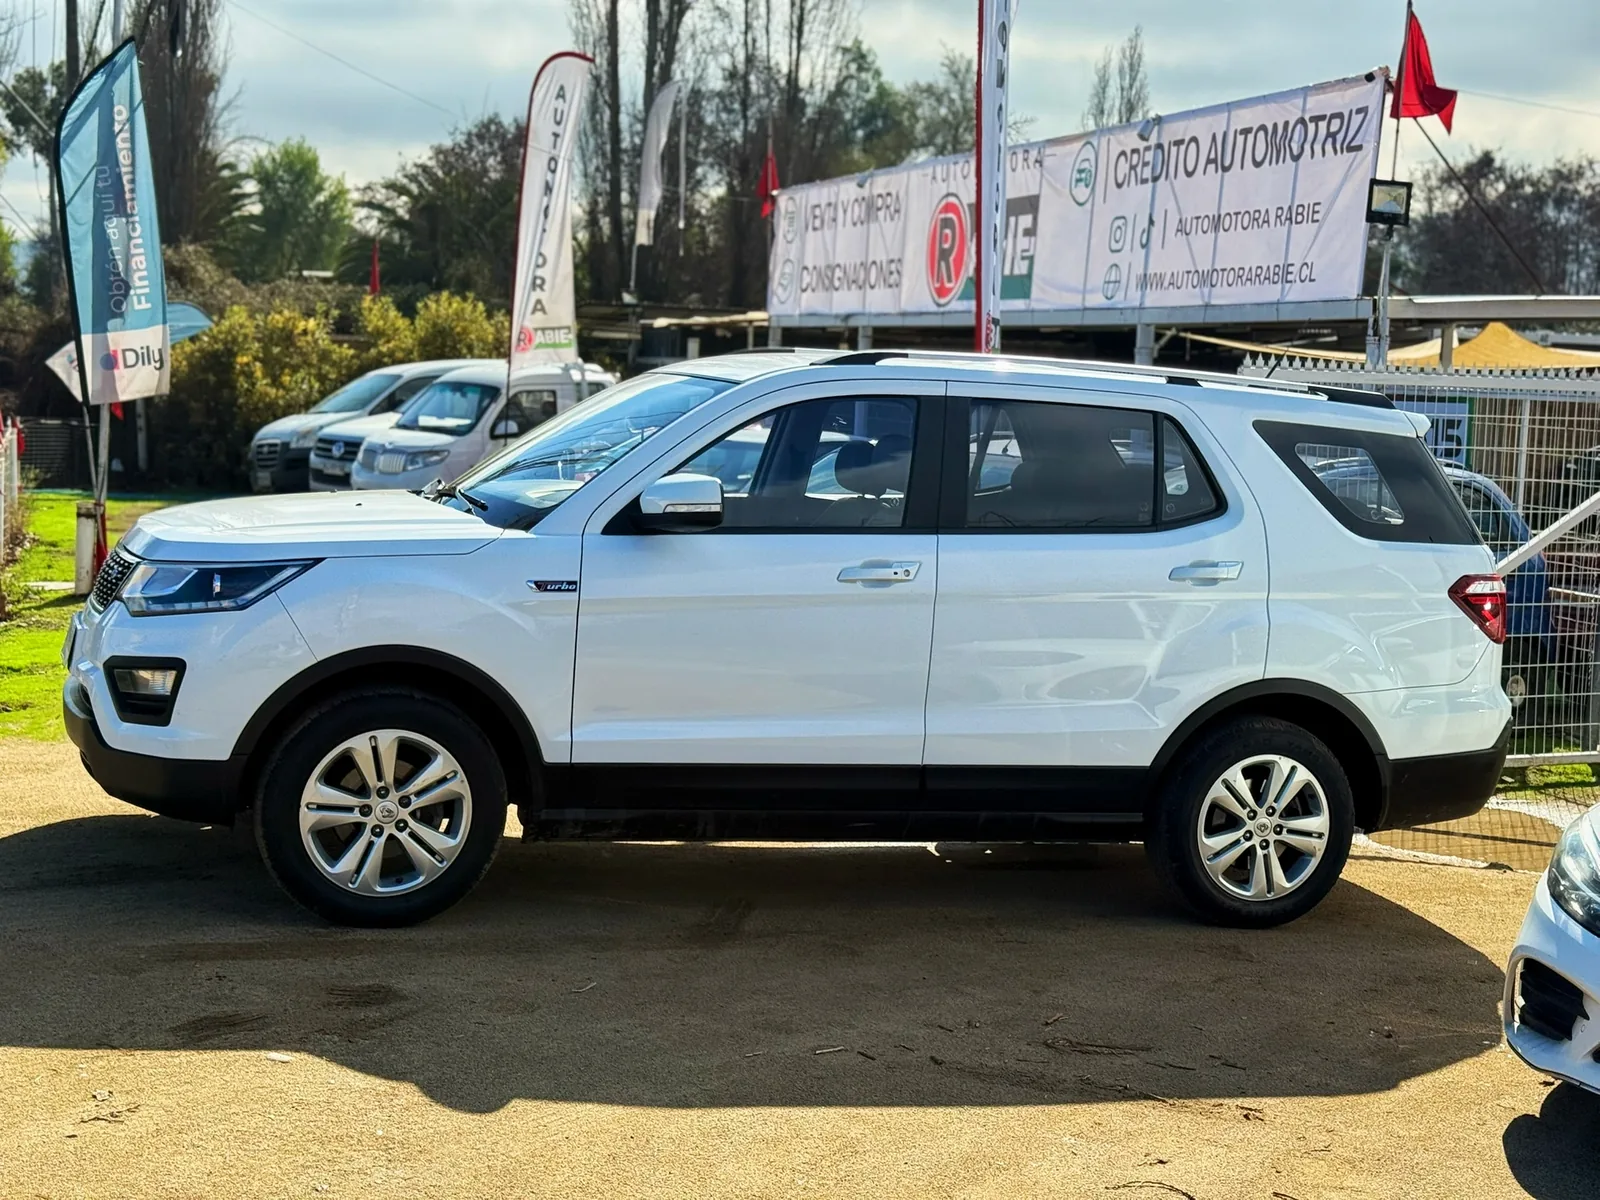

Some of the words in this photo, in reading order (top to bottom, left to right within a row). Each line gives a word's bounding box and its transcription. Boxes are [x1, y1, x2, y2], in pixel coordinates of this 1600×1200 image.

[1198, 105, 1369, 176] AUTOMOTRIZ
[96, 165, 111, 189] tu
[100, 193, 120, 241] aquí
[113, 104, 151, 311] Financiamiento
[840, 198, 850, 228] Y
[851, 190, 901, 228] COMPRA
[1174, 208, 1271, 238] AUTOMOTORA
[1273, 201, 1322, 228] RABIE
[1135, 261, 1317, 292] WWW.AUTOMOTORARABIE.CL
[121, 346, 164, 371] Dily
[537, 581, 576, 590] Turbo
